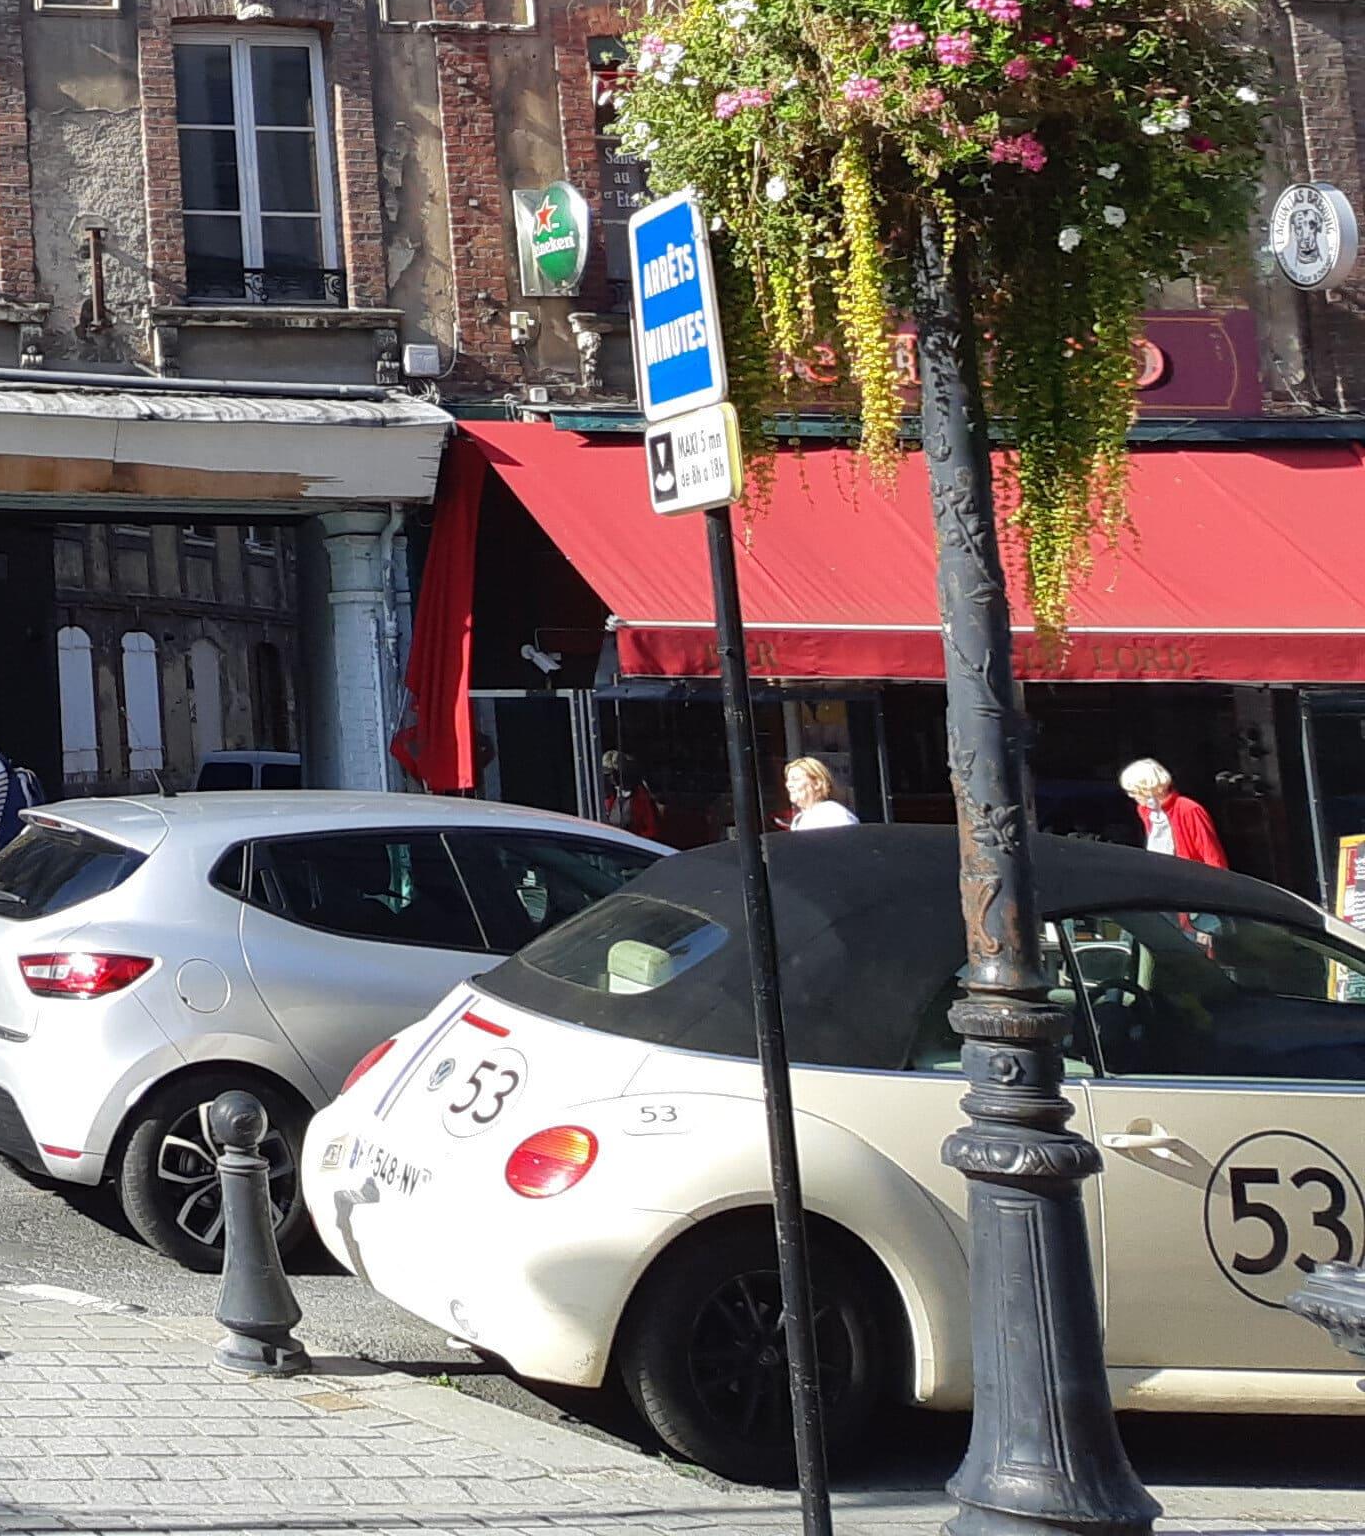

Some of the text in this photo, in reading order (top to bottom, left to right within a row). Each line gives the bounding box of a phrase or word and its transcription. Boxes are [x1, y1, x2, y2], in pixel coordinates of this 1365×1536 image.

[614, 172, 630, 184] au
[643, 243, 695, 298] ARRÊTS
[644, 310, 707, 366] MINUTES
[677, 431, 698, 459] MAXI
[700, 429, 706, 453] 5
[681, 467, 690, 487] de
[692, 464, 701, 485] 8h
[710, 456, 725, 479] 18h
[449, 1060, 519, 1124] 53
[640, 1104, 678, 1123] 53
[1228, 1166, 1353, 1275] 53
